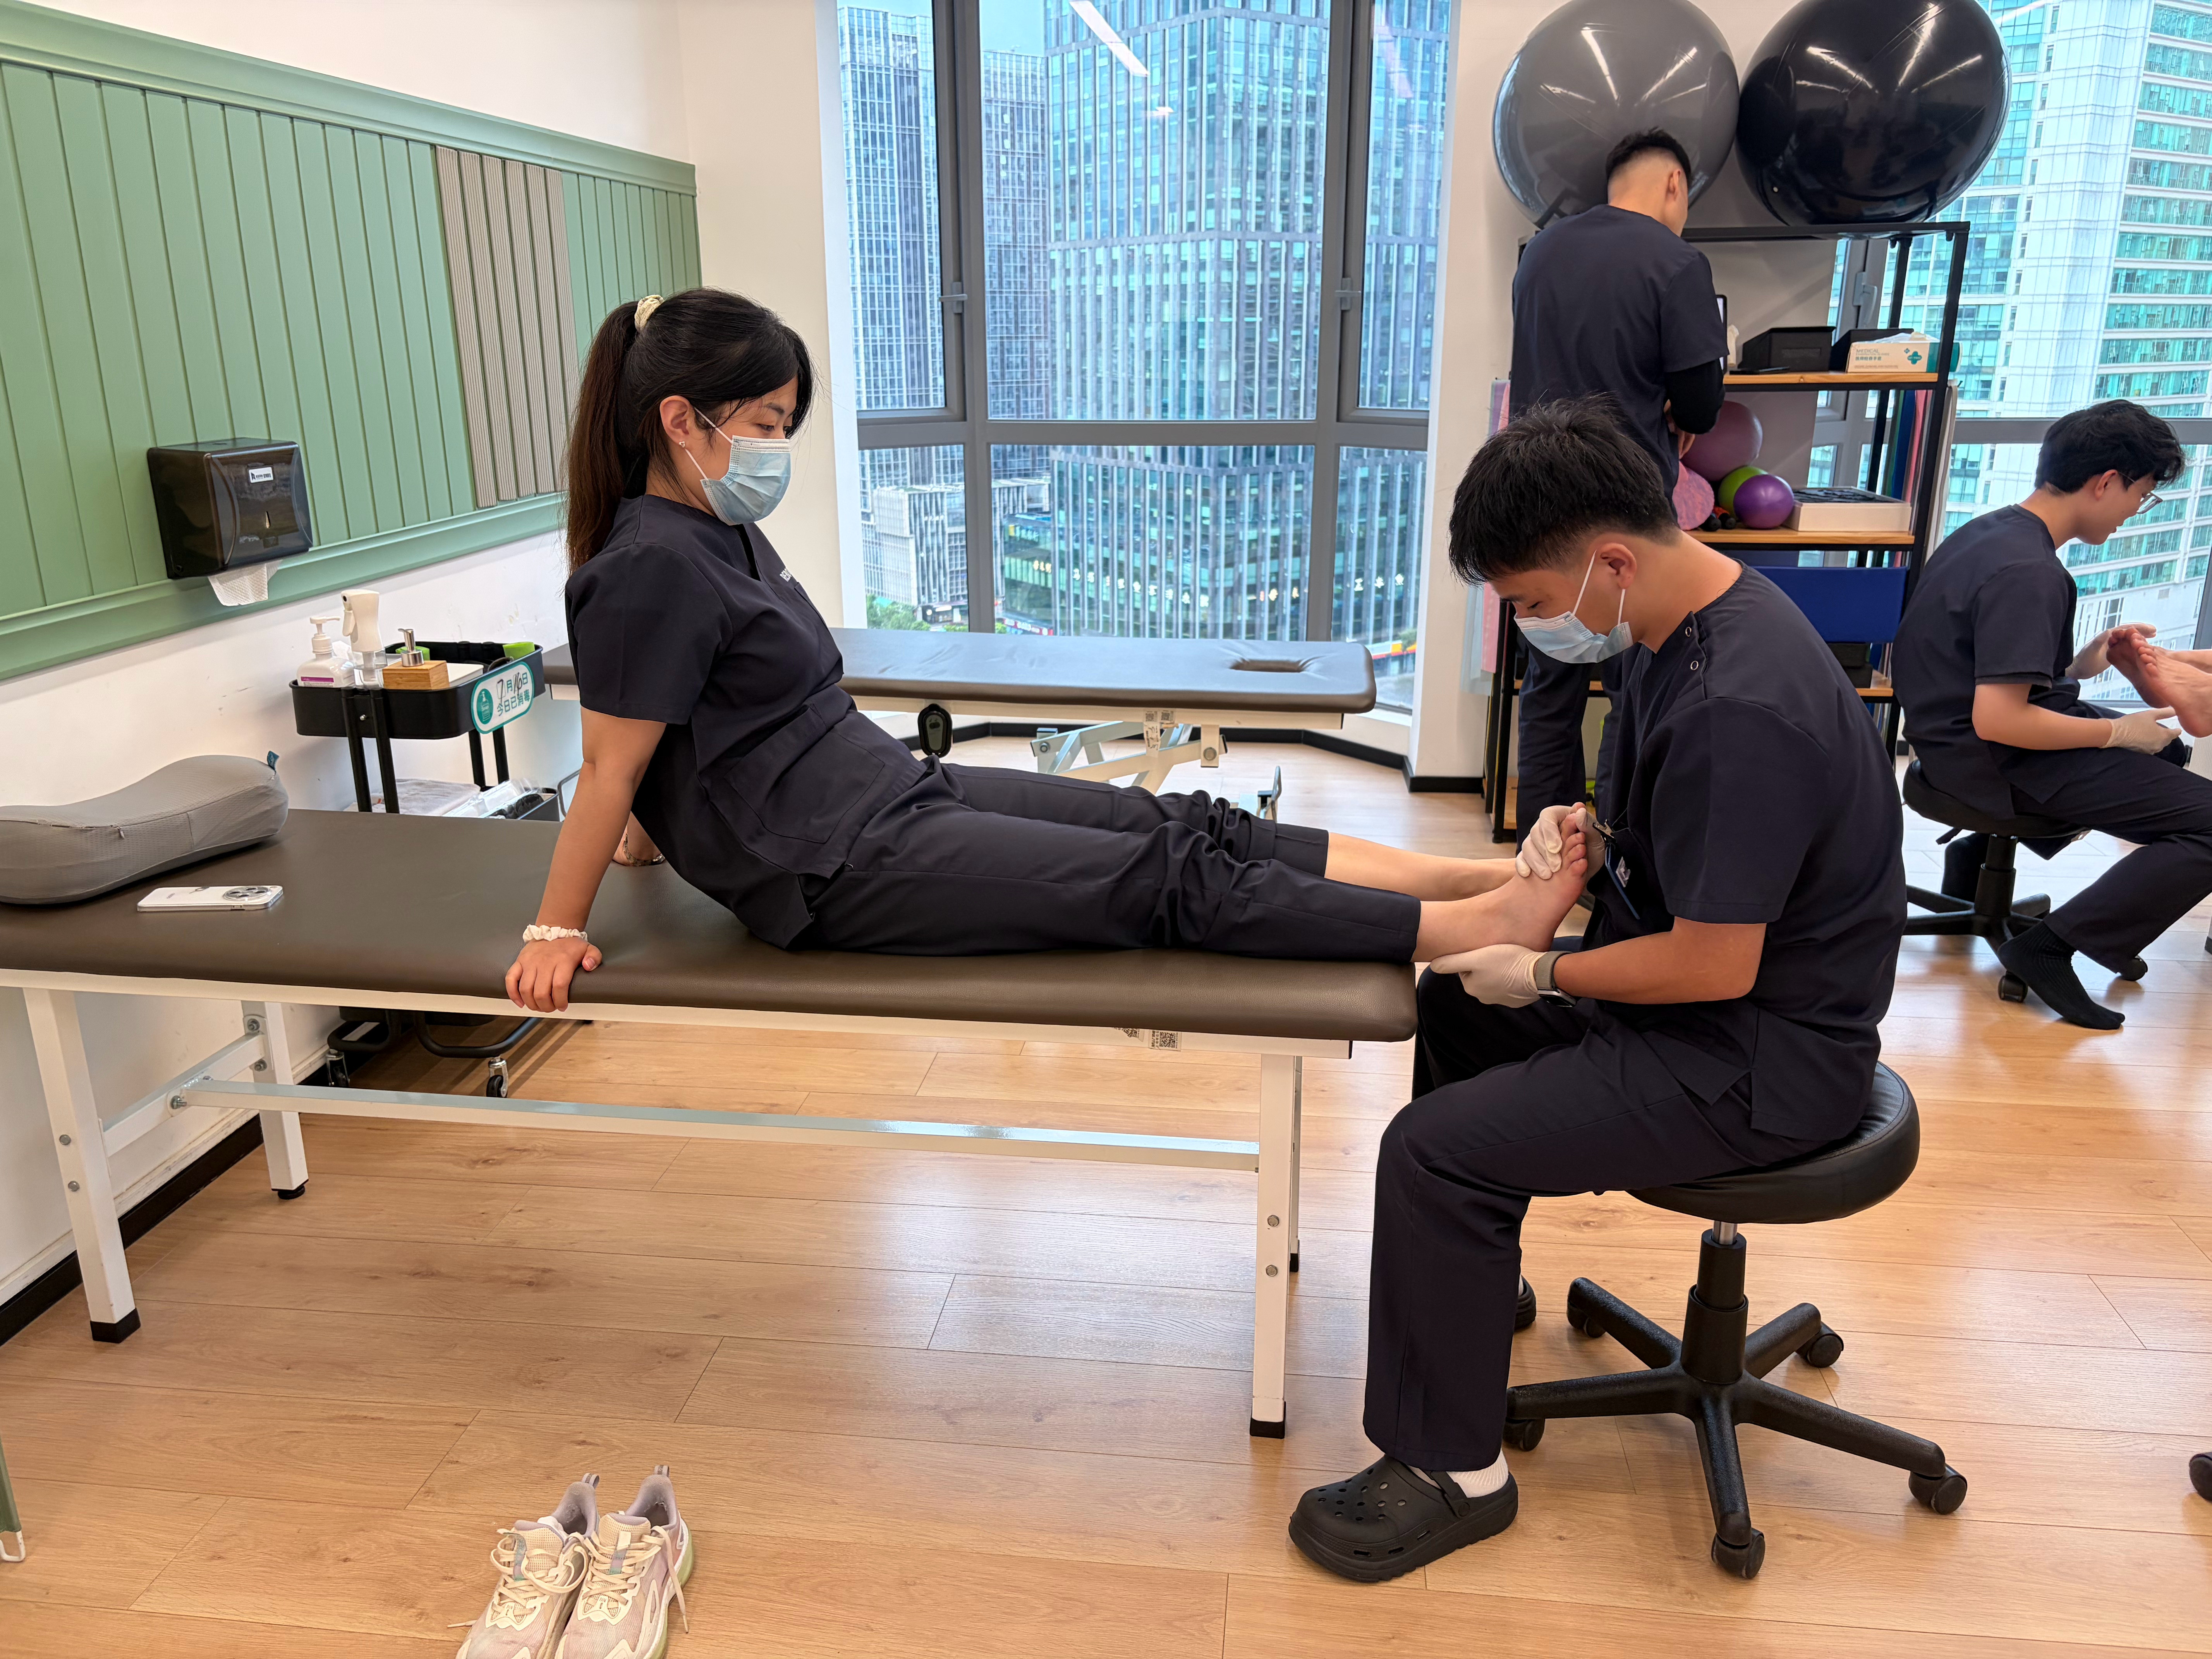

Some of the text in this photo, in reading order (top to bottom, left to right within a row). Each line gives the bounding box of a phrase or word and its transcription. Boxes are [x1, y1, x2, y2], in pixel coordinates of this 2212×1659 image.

[497, 689, 530, 716] 今日已消毒
